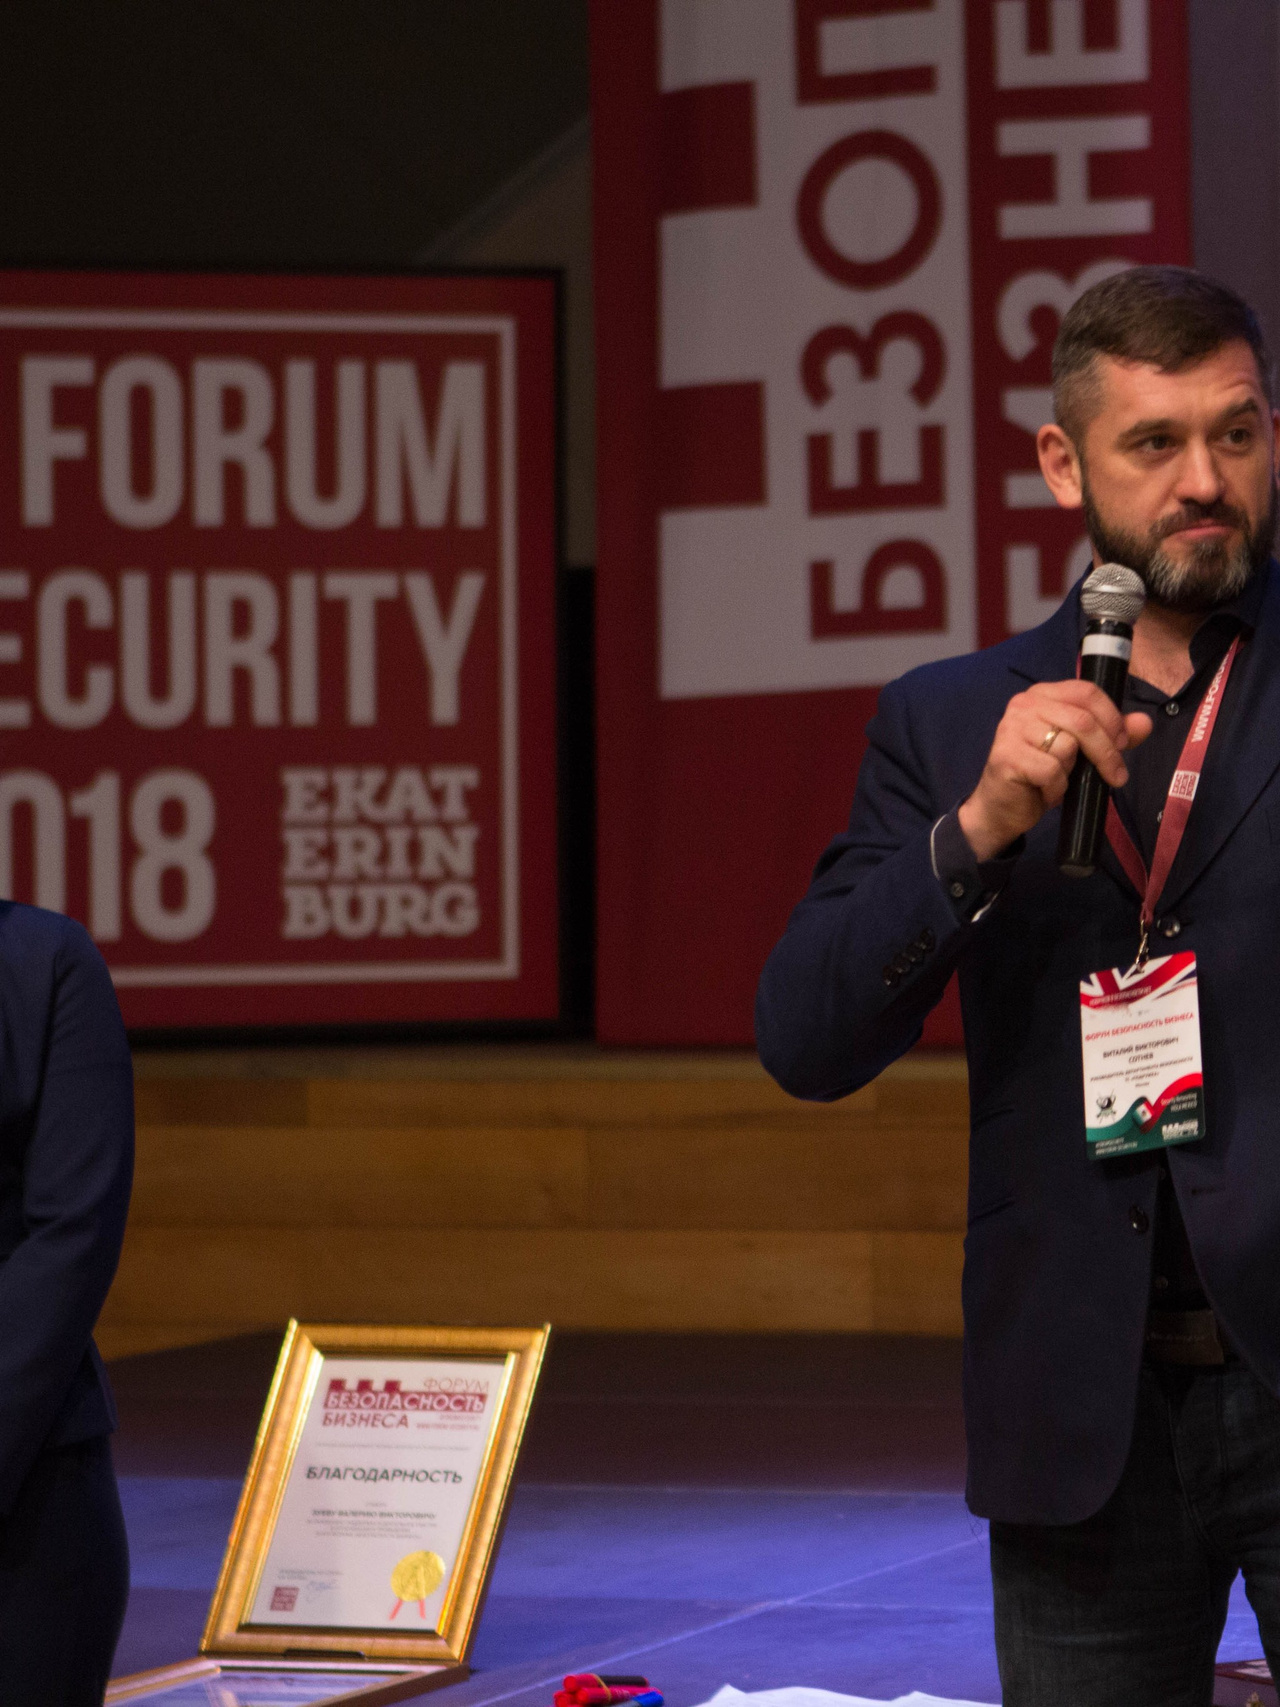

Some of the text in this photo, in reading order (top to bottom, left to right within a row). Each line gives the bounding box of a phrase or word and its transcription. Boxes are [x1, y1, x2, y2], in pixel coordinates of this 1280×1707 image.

[795, 0, 949, 642] БЕЗОП
[20, 355, 487, 530] FORUM
[282, 766, 480, 822] EKAT
[282, 825, 480, 880] ERIN
[282, 883, 480, 939] BURG
[1085, 1012, 1195, 1042] ФОРУМ БЕЗОПАСНОСТЬ БИЗНЕСА
[1103, 1036, 1179, 1059] ВИТАЛИЙ ВИКТОРОВИЧ
[423, 1376, 490, 1393] ФОРУМ
[326, 1391, 485, 1412] БЕЗОПАСНОСТЬ
[322, 1412, 410, 1429] БИЗНЕСА
[305, 1465, 464, 1485] БЛАГОДАРНОСТЬ
